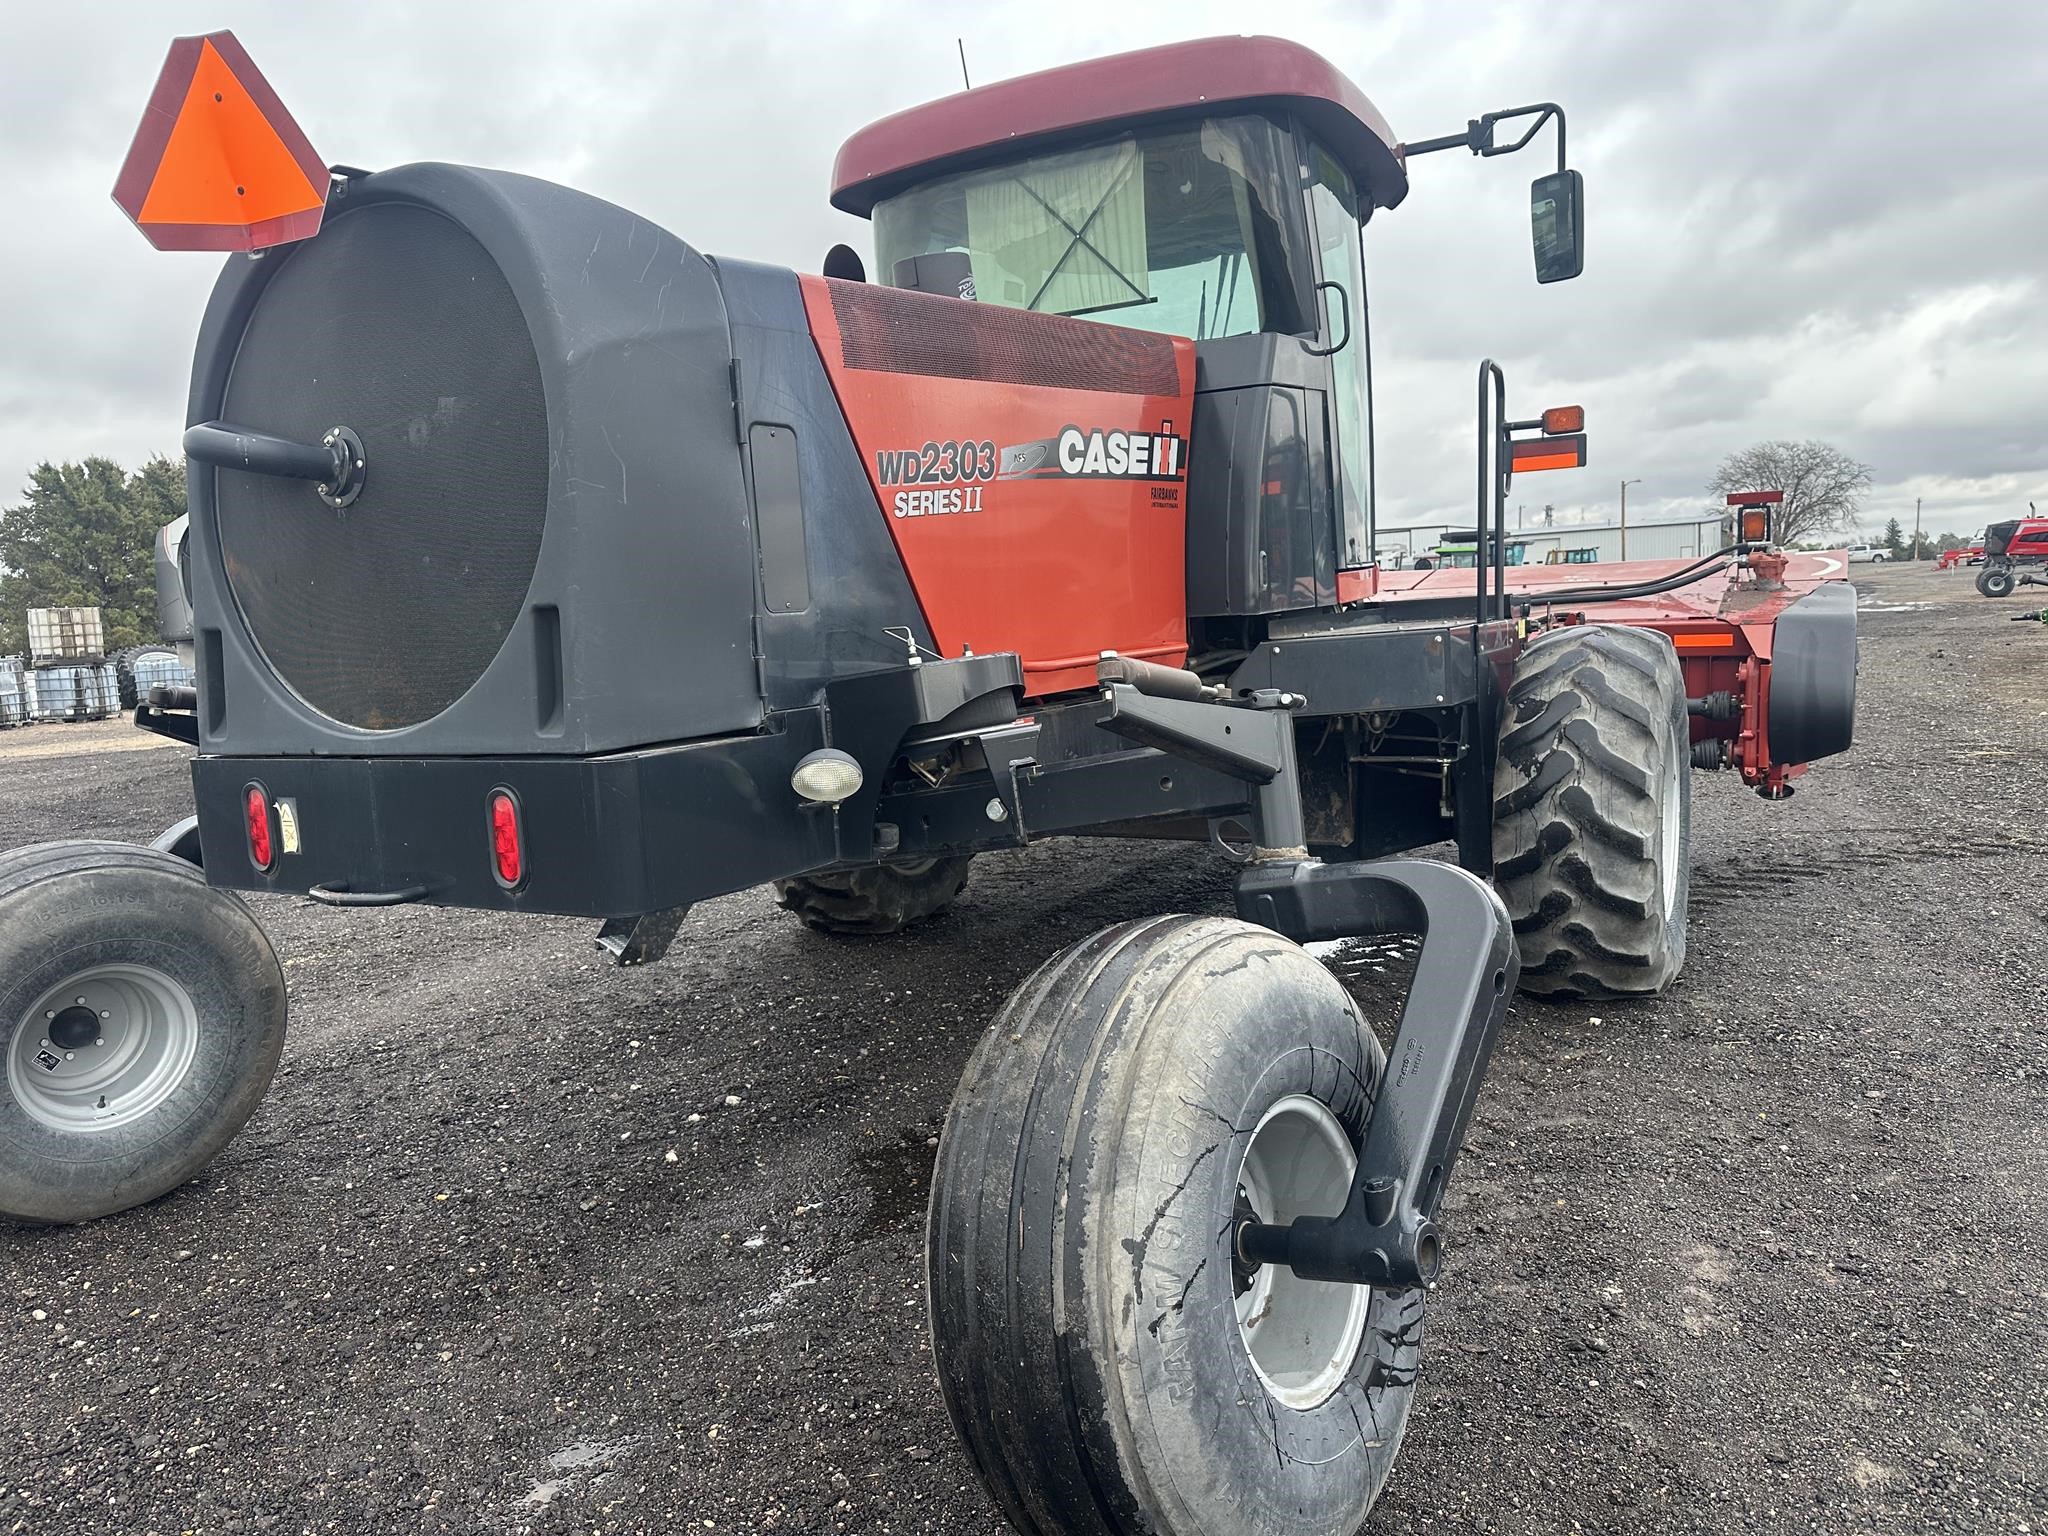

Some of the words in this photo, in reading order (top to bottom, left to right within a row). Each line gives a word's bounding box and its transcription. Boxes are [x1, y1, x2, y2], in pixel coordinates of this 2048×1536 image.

[876, 440, 996, 487] WD2303
[1058, 427, 1151, 475] CASE
[893, 488, 962, 518] SERIES
[963, 486, 984, 513] II
[1151, 487, 1179, 501] FAIRBANKS
